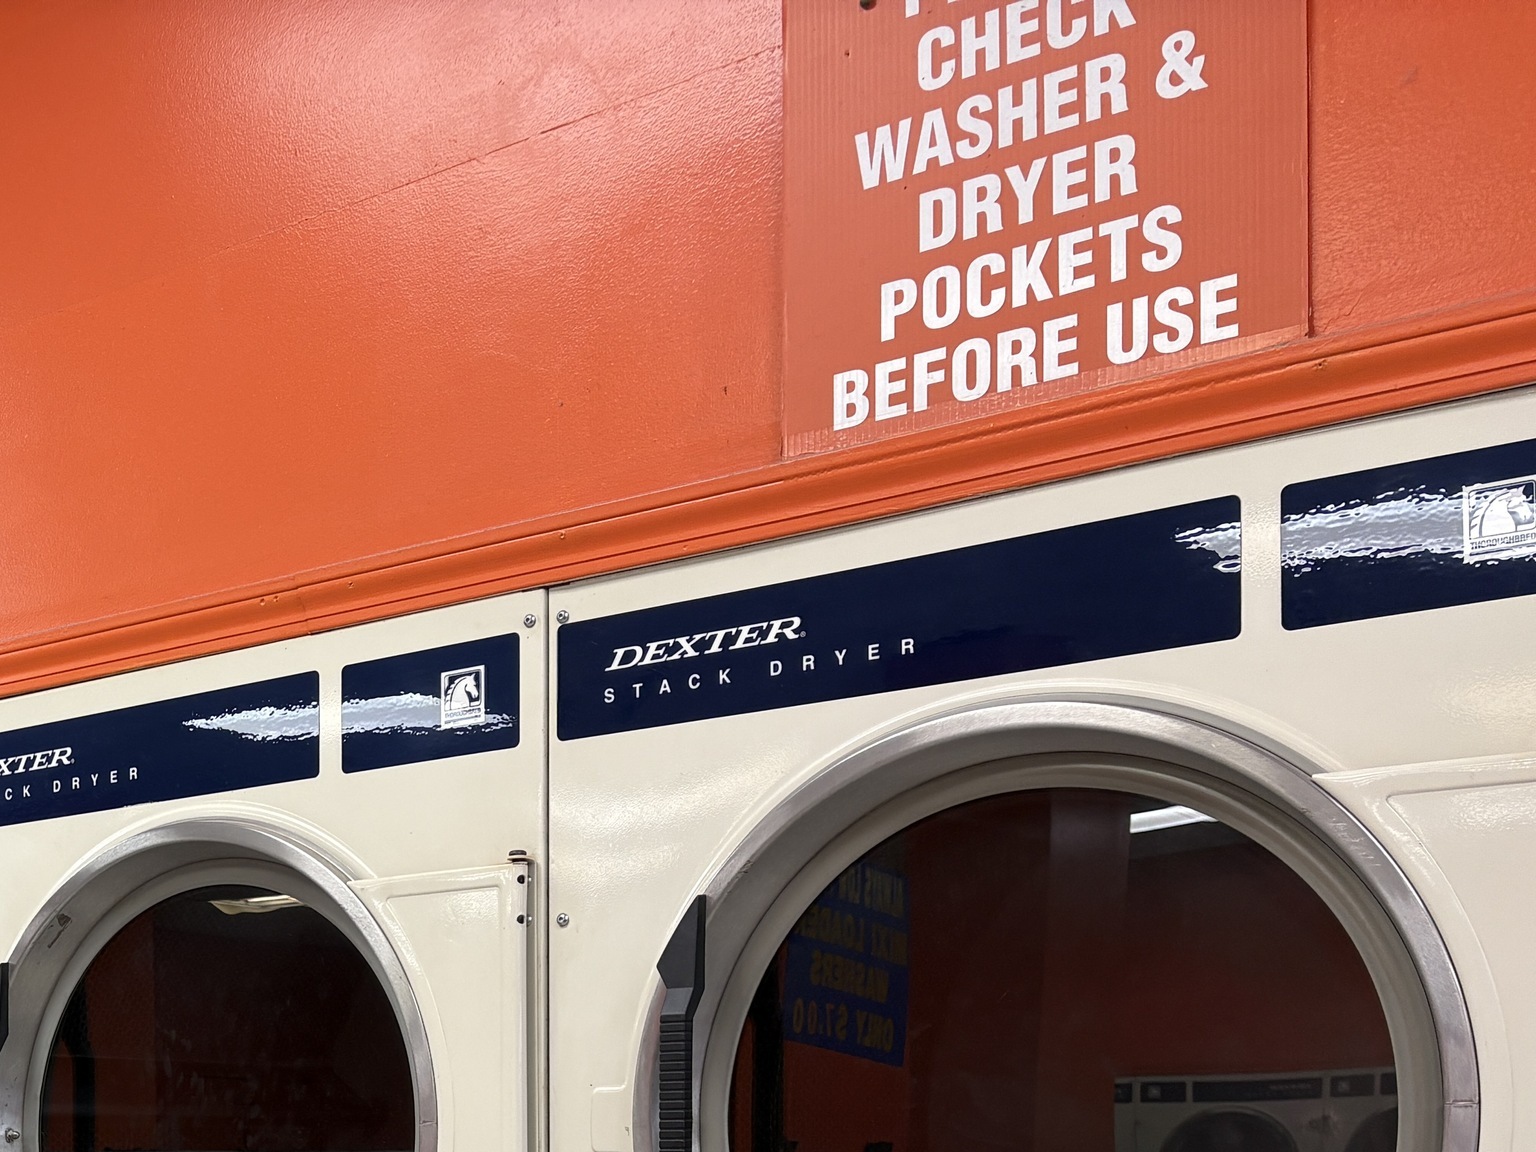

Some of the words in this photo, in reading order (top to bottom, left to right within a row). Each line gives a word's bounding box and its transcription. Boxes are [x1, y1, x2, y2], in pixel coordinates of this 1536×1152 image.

[918, 0, 1136, 91] CHECK
[854, 53, 1129, 190] WASHER
[1155, 30, 1208, 99] &
[919, 134, 1138, 253] DRYER
[880, 205, 1182, 342] POCKETS
[833, 313, 1079, 431] BEFORE
[1106, 274, 1239, 365] USE
[604, 668, 731, 703] STACK
[770, 638, 914, 676] DRYER
[605, 616, 802, 671] DEXTER
[53, 767, 138, 793] DRYER
